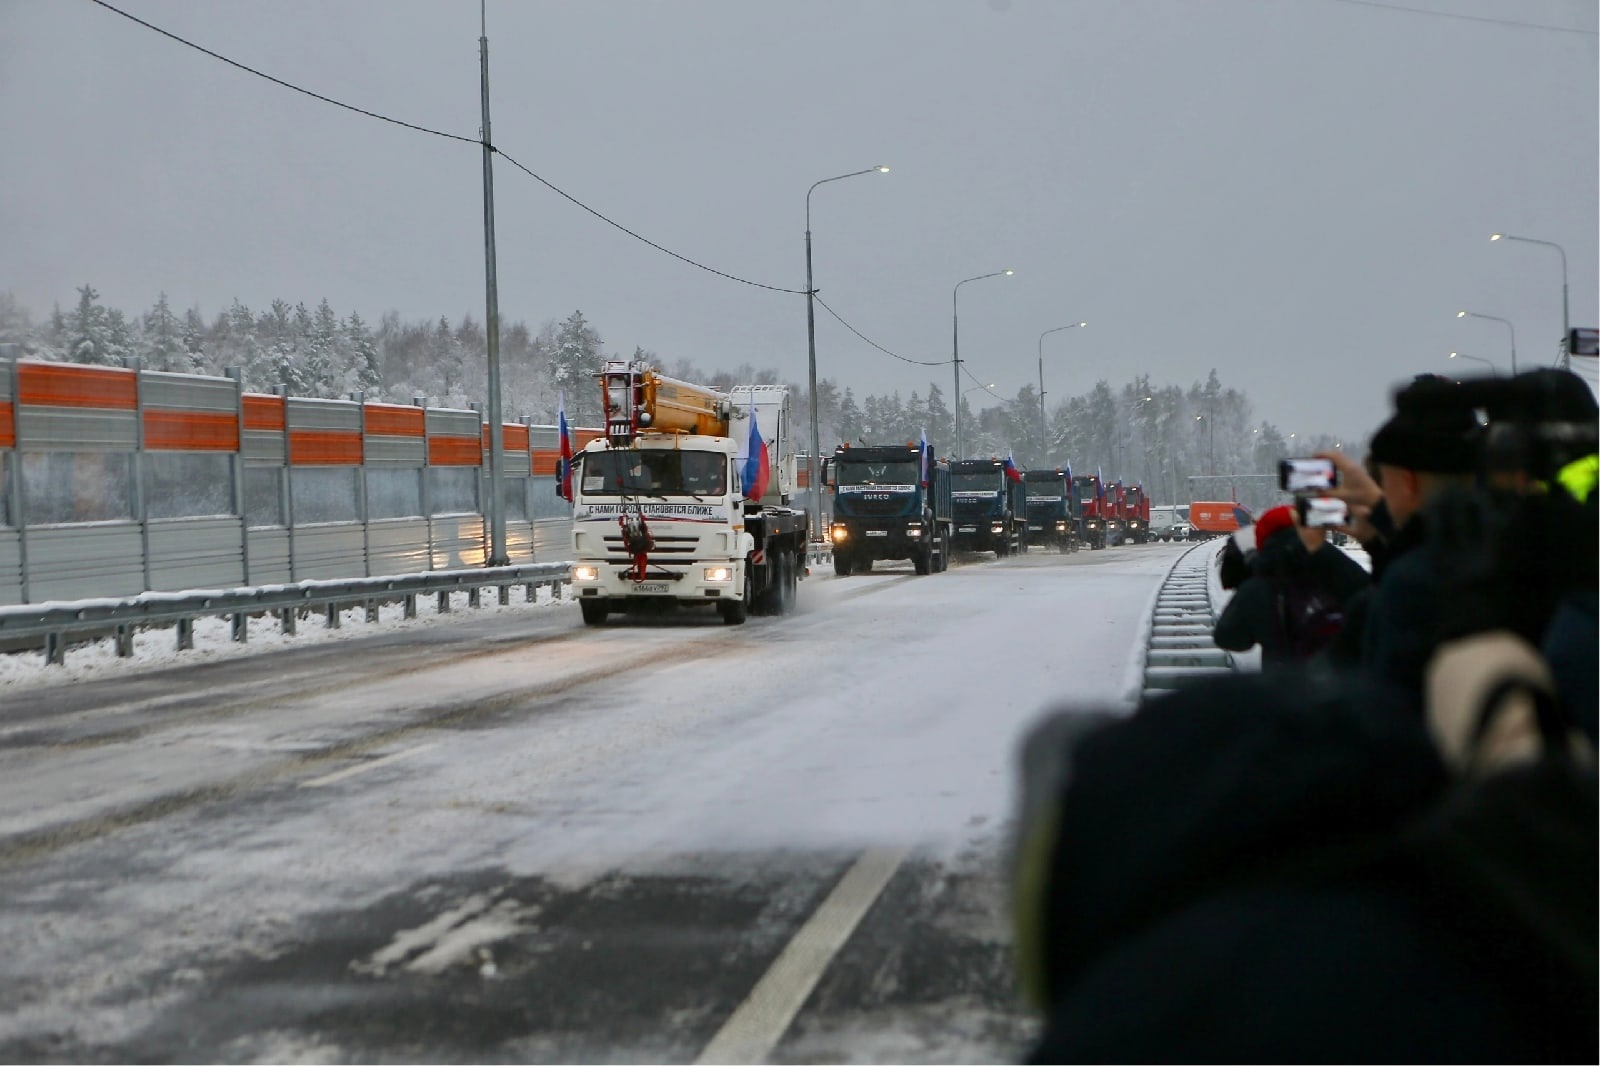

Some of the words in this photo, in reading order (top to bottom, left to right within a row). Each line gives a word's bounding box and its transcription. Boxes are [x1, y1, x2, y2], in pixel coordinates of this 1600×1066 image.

[589, 505, 594, 514] С
[595, 505, 615, 514] НАМИ
[643, 505, 686, 514] СТАНОВЯТСЯ
[687, 505, 713, 516] БЛИЖЕ
